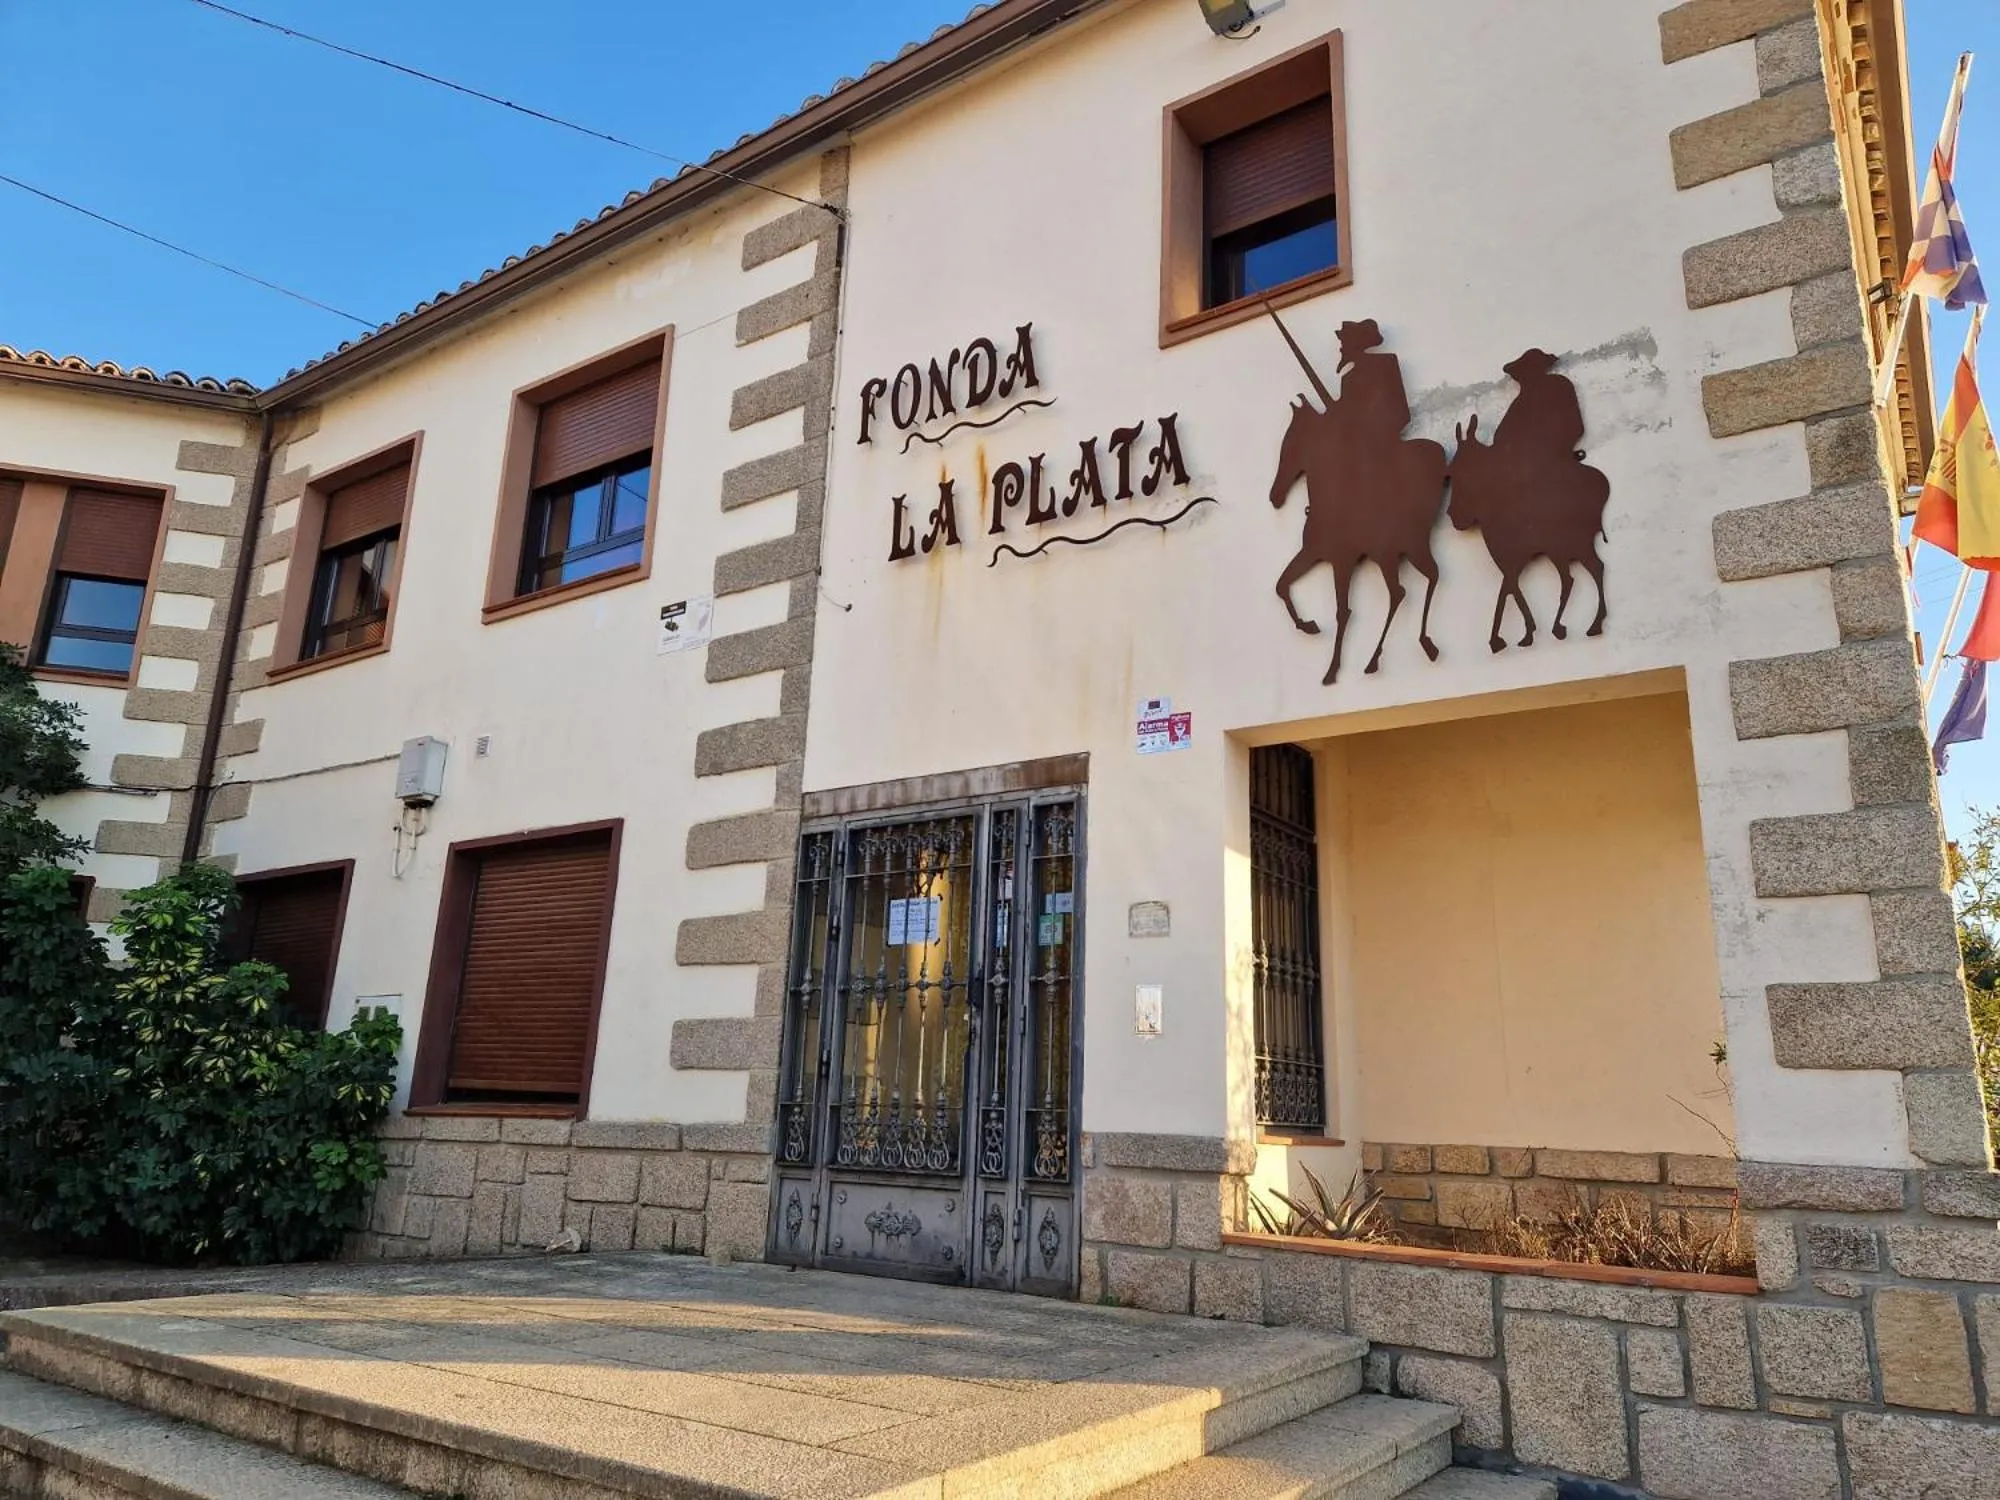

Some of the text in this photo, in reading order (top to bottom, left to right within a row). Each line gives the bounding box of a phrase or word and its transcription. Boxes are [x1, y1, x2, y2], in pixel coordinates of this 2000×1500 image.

[856, 321, 1040, 445] FONDA
[888, 411, 1191, 562] LA PLATA
